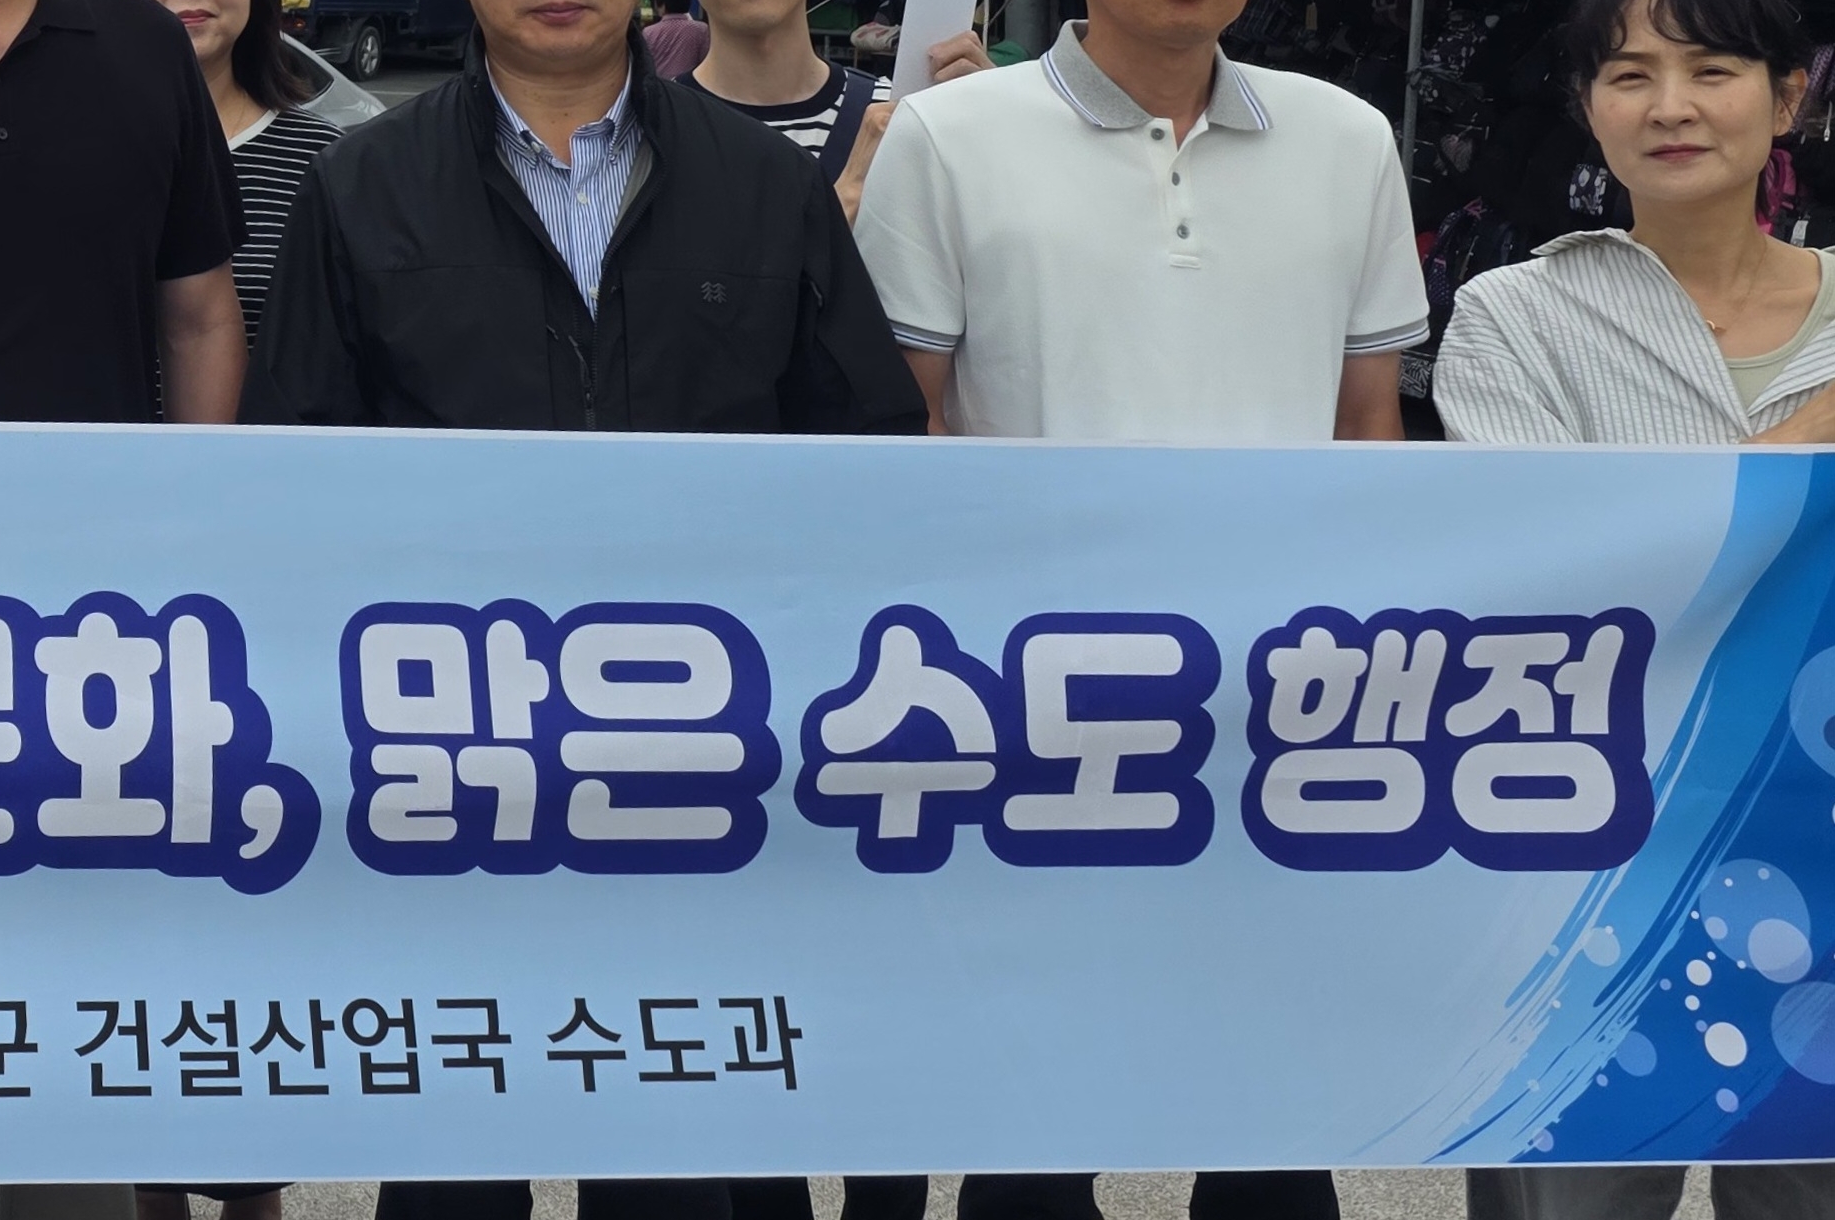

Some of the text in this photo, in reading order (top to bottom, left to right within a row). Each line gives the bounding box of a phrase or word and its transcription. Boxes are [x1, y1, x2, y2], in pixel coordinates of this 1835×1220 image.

[359, 619, 744, 841] 맑은
[816, 625, 1183, 838] 수도
[1260, 624, 1625, 833] 행정
[75, 998, 512, 1097] 건설산업국
[546, 996, 803, 1093] 수도과
